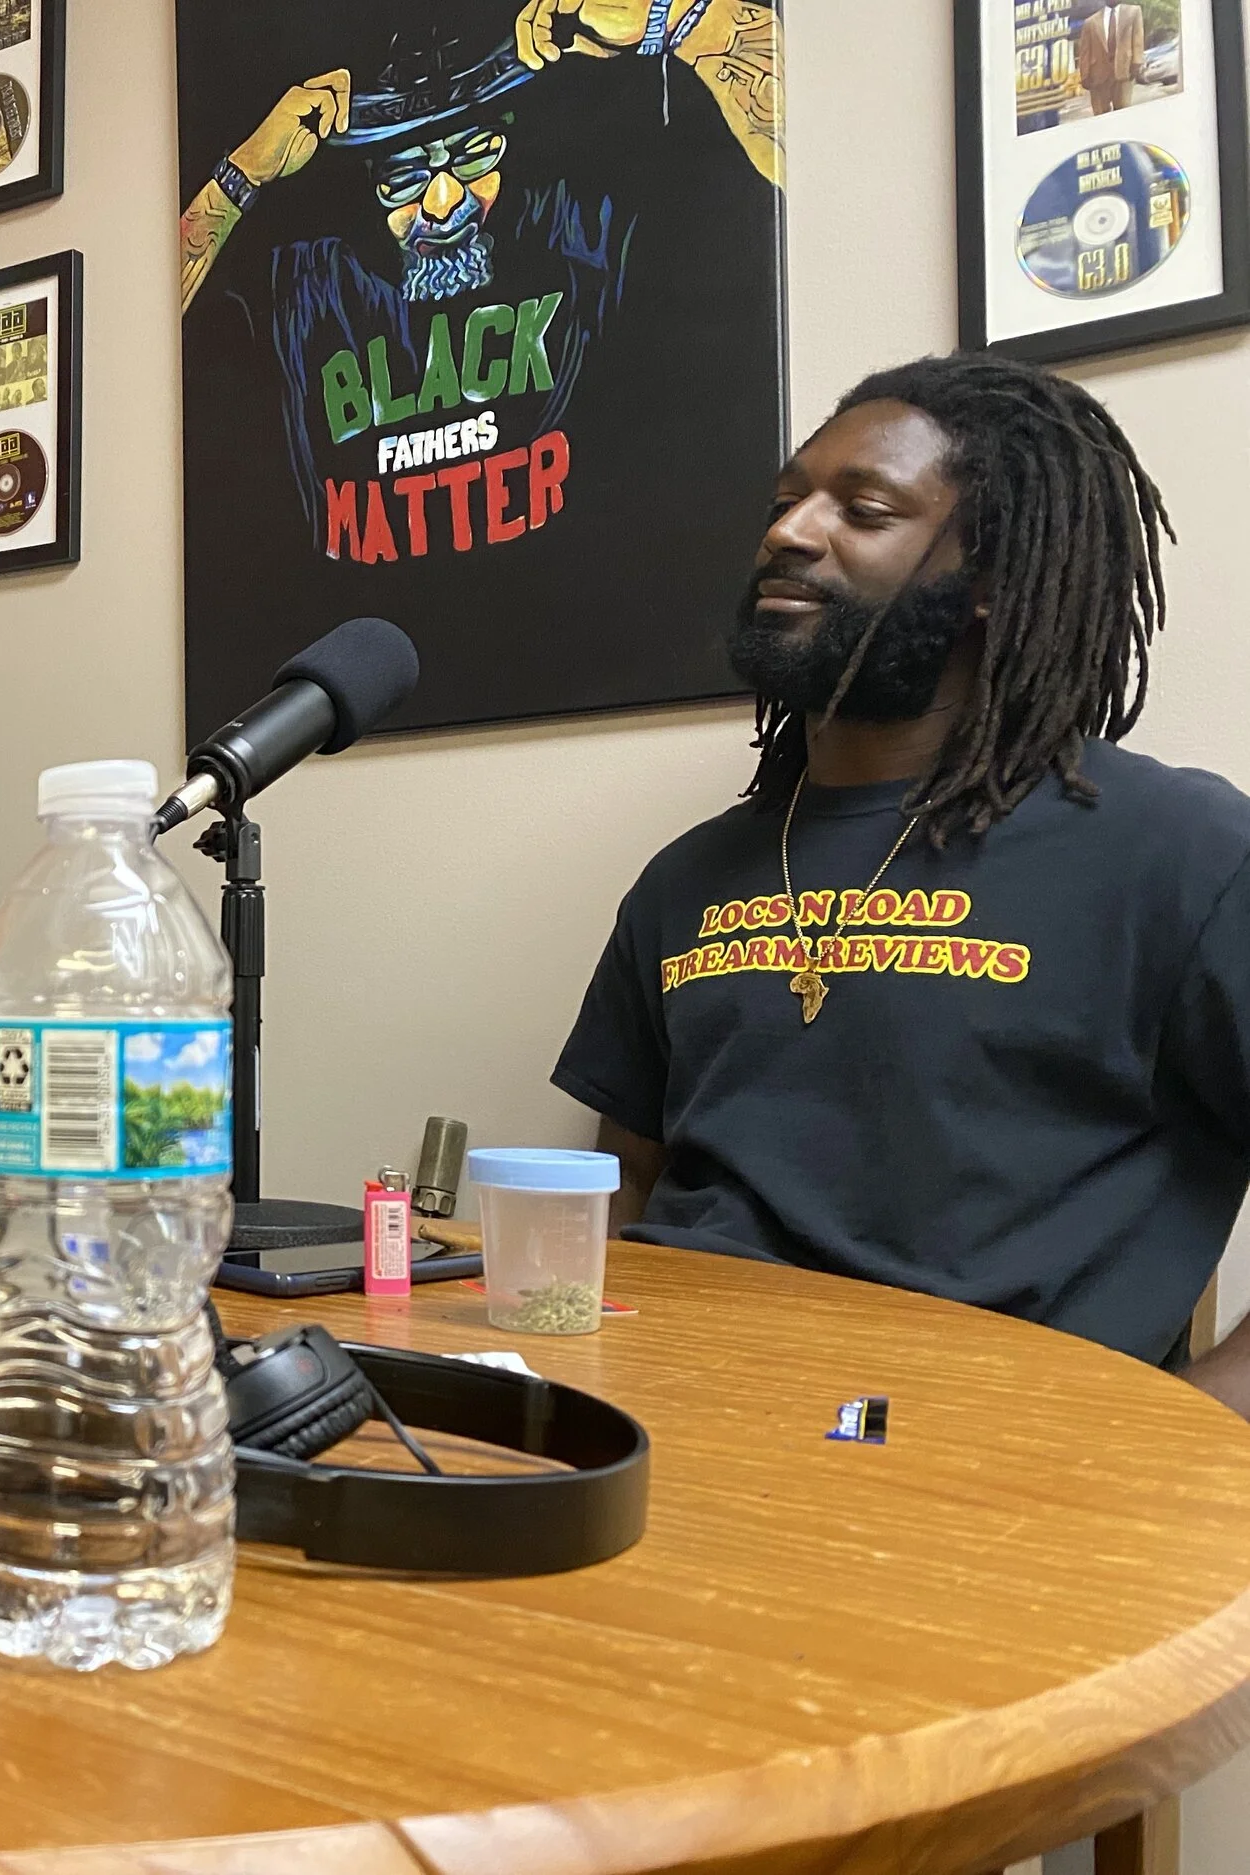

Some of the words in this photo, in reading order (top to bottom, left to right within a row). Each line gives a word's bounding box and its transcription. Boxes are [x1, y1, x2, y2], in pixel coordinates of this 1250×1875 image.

[1015, 38, 1070, 94] G3.0
[1078, 243, 1130, 291] G3.0
[321, 292, 563, 444] BLACK
[377, 410, 499, 474] FATHERS
[325, 430, 570, 565] MATTER
[697, 893, 793, 938] LOCS
[797, 890, 834, 927] N
[838, 889, 971, 927] LOAD
[661, 937, 808, 994] FIREARM
[815, 935, 1032, 984] REVIEWS
